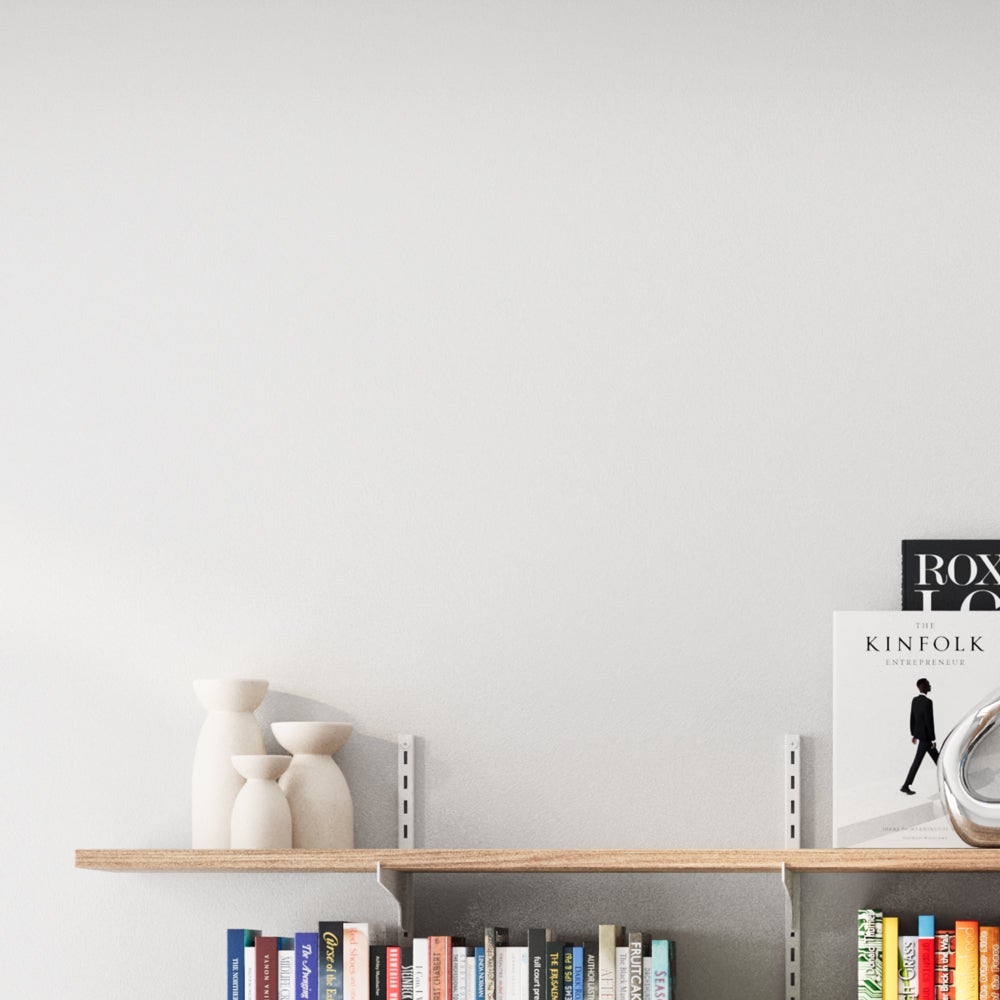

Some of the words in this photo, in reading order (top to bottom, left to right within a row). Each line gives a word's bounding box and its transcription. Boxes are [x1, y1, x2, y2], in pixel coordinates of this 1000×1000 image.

[916, 622, 934, 630] THE
[866, 636, 984, 652] KINFOLK
[302, 944, 312, 959] The
[323, 932, 338, 962] Curse
[326, 964, 336, 973] of
[349, 948, 358, 975] Shoes
[550, 952, 558, 966] THE
[587, 955, 595, 982] AUTHOR
[900, 942, 916, 980] GRASS
[921, 942, 930, 984] graphics
[980, 955, 988, 982] Other
[280, 956, 290, 988] MIDLIFE
[301, 960, 312, 999] Avenging
[326, 974, 336, 986] the
[402, 966, 413, 1000] STEINBECK
[574, 966, 582, 988] DARK
[620, 968, 628, 986] Black
[992, 974, 1000, 990] the
[980, 984, 988, 1000] the
